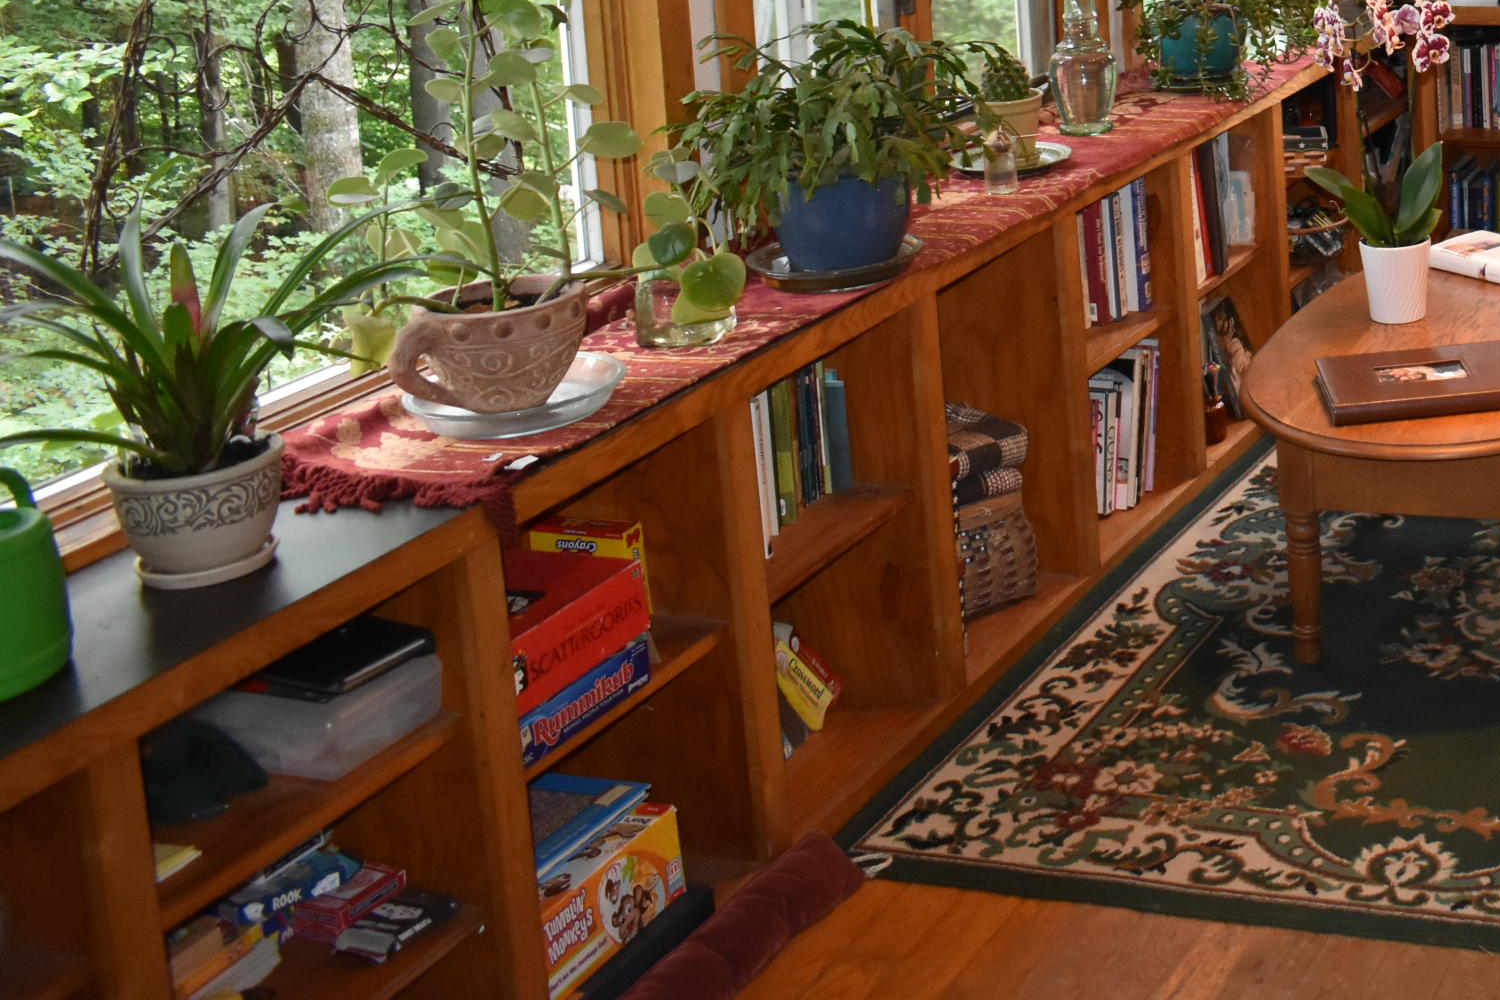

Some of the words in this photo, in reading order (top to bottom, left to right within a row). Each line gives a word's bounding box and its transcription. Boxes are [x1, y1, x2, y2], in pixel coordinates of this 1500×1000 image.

[556, 539, 598, 553] Crayons
[529, 593, 643, 682] SCATTERGORIES
[788, 657, 825, 700] Crossword
[531, 661, 635, 746] Rummikub
[582, 704, 600, 721] PEOPLE
[271, 888, 302, 912] ROOK
